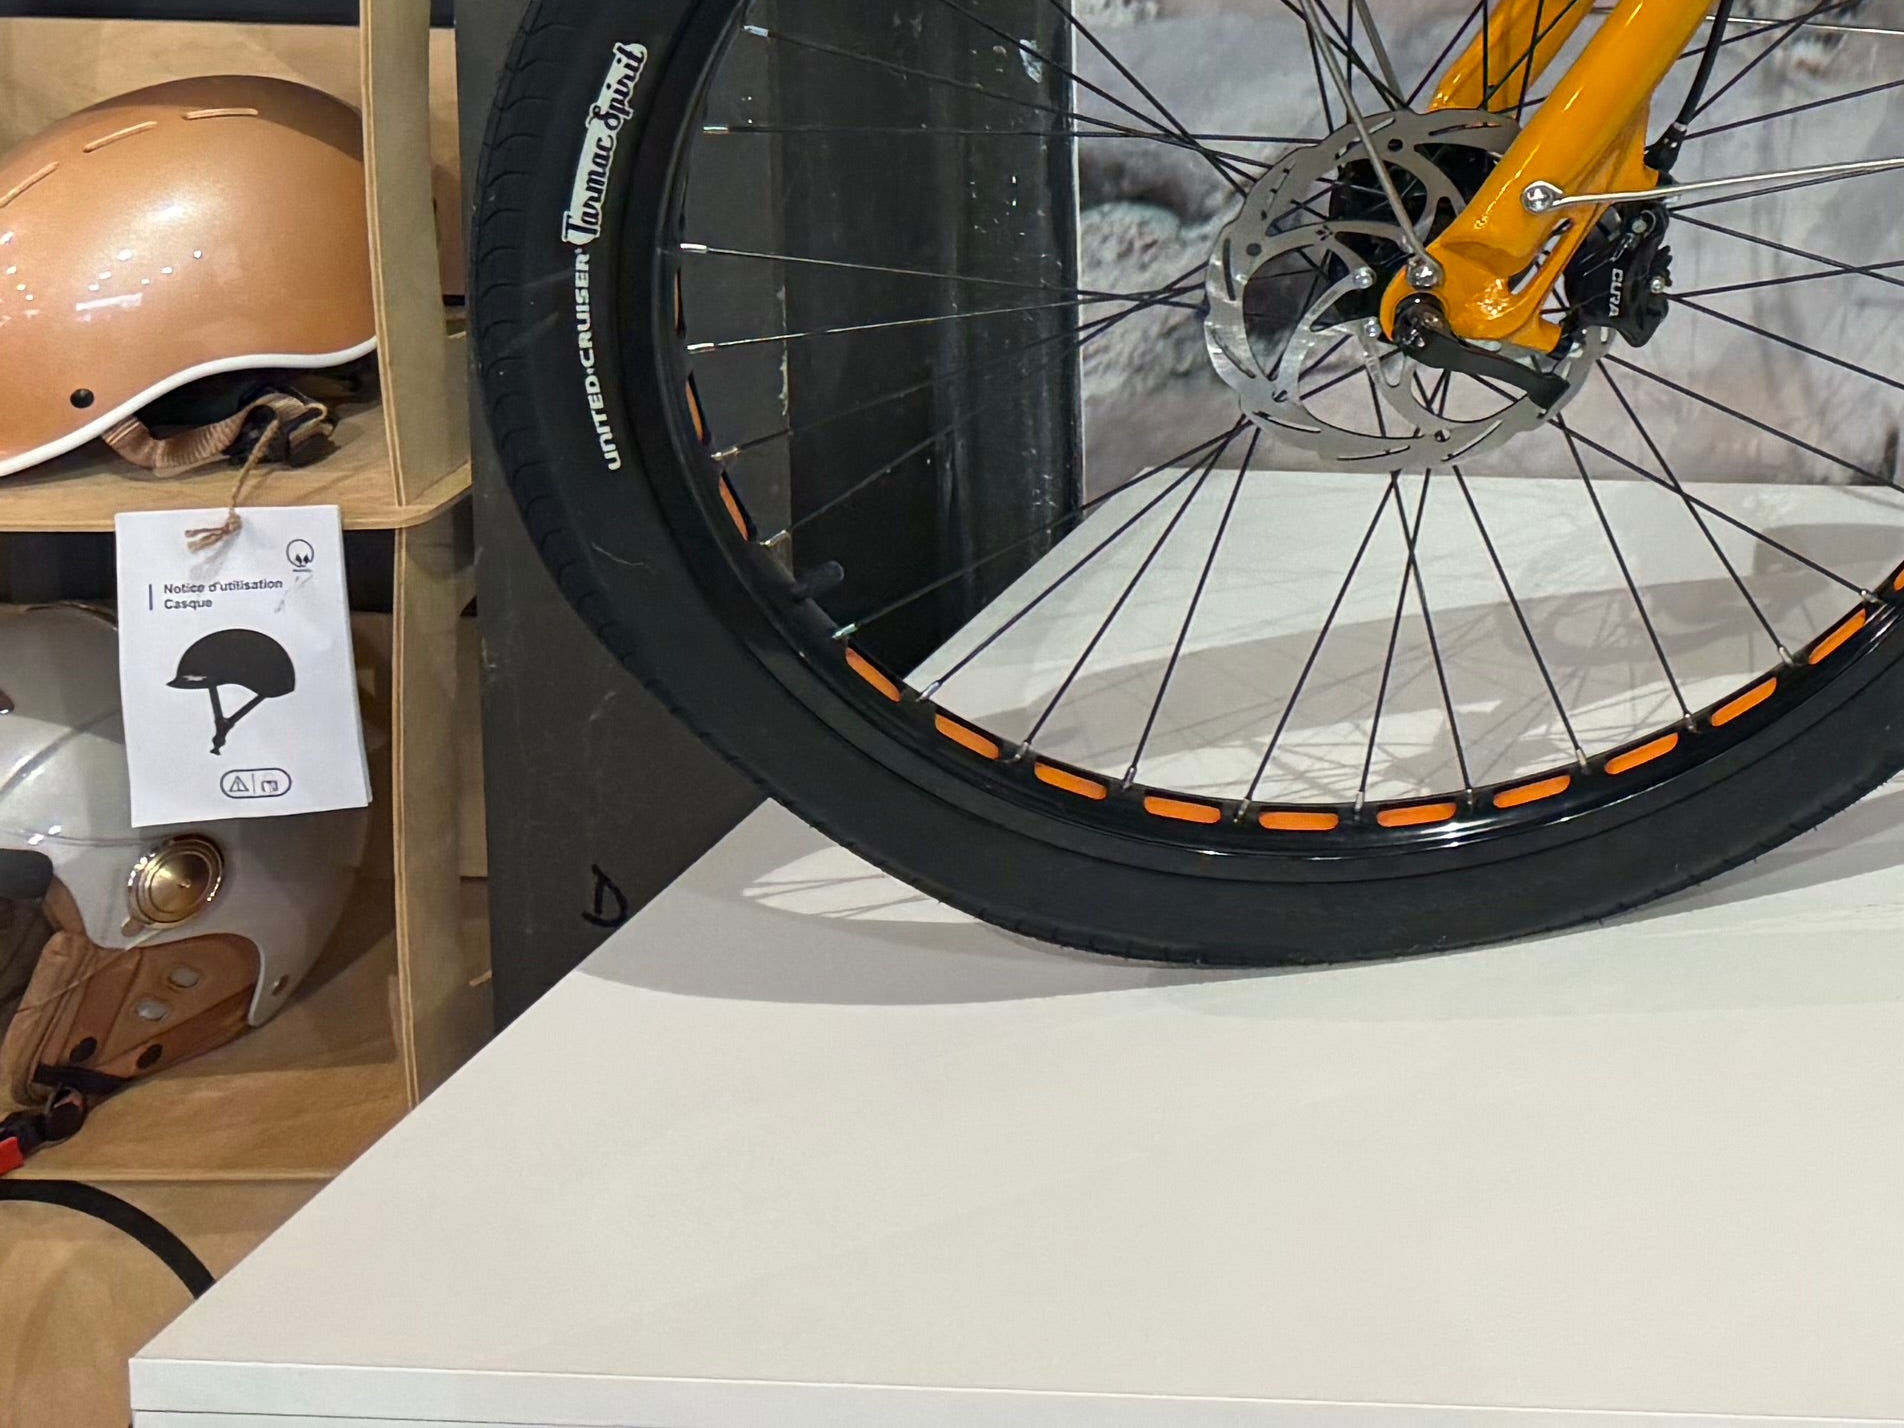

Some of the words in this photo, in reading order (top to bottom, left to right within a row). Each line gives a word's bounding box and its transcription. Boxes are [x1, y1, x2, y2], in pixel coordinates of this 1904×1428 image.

[587, 44, 646, 132] Spirit
[564, 134, 615, 241] Tarmac
[1608, 267, 1624, 317] CURA
[163, 583, 205, 594] Notice
[208, 578, 283, 593] d'utilisation
[163, 598, 213, 610] Casque
